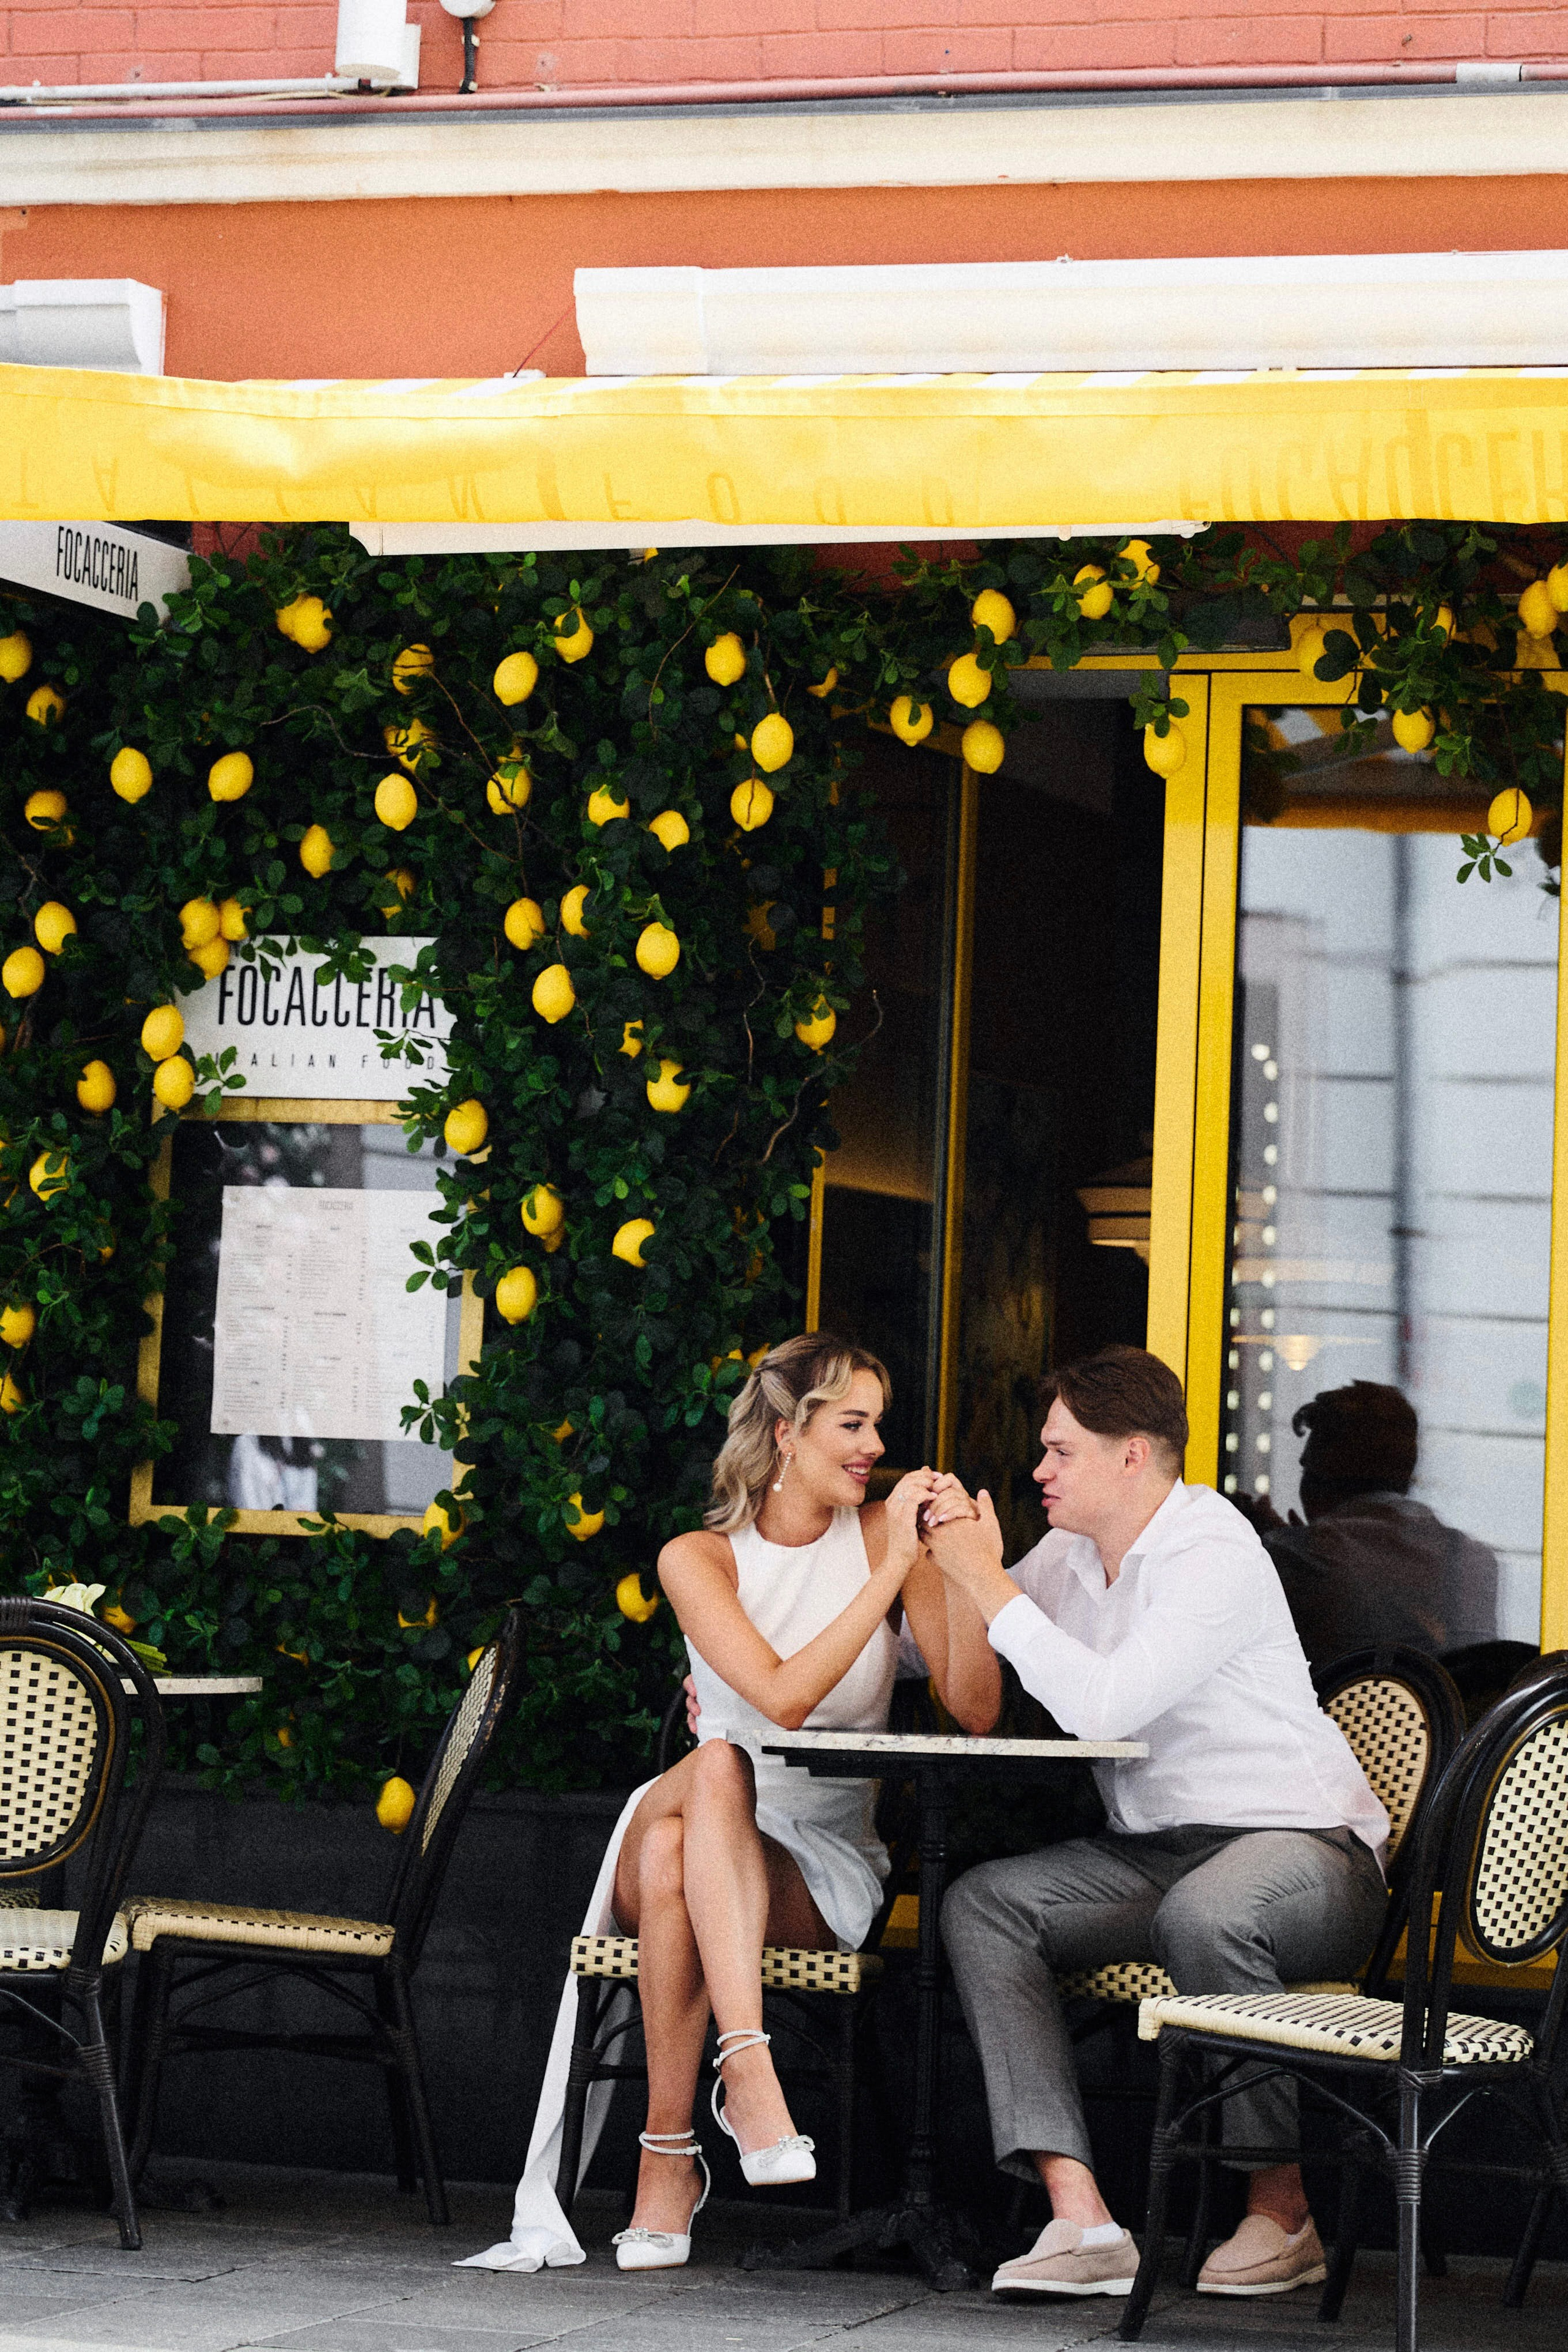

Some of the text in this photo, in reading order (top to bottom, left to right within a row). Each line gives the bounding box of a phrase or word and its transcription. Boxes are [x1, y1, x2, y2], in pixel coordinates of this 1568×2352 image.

[56, 526, 139, 602] FOCACCERIA
[218, 964, 435, 1028] FOCACCERA
[215, 1052, 336, 1068] IALIAN
